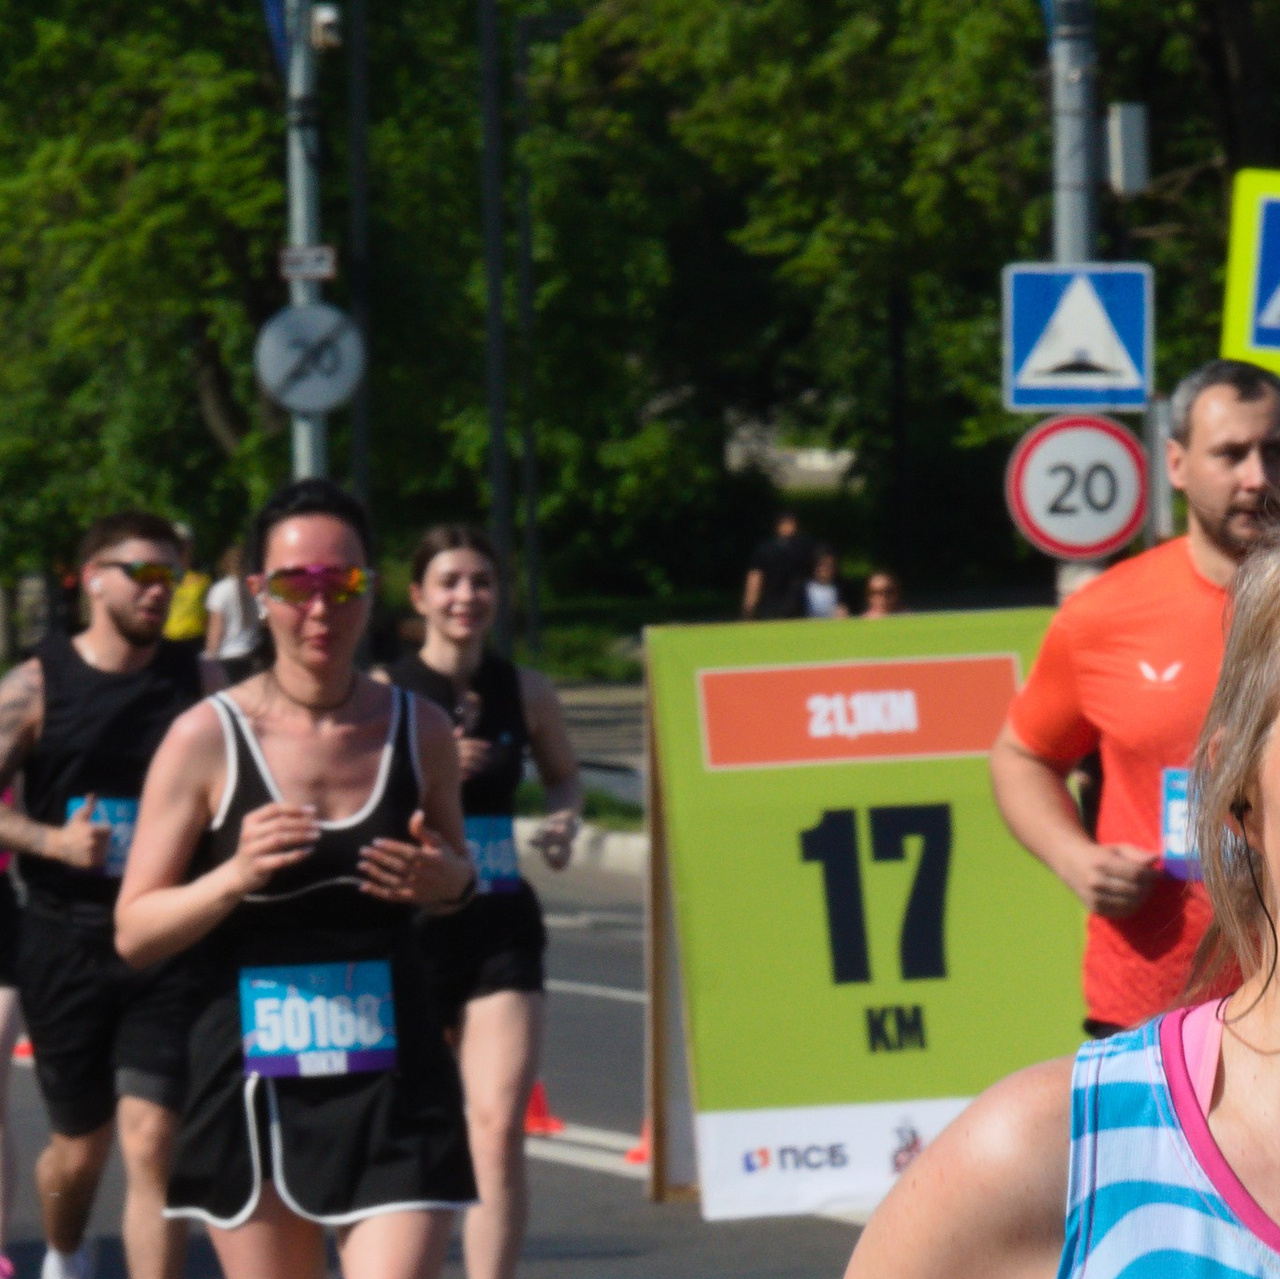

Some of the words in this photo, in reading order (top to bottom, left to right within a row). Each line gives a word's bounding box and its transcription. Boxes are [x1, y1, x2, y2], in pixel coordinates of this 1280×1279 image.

[1048, 463, 1118, 516] 20
[799, 803, 952, 985] 17
[866, 1004, 926, 1052] KM
[778, 1143, 848, 1170] ПСБ
